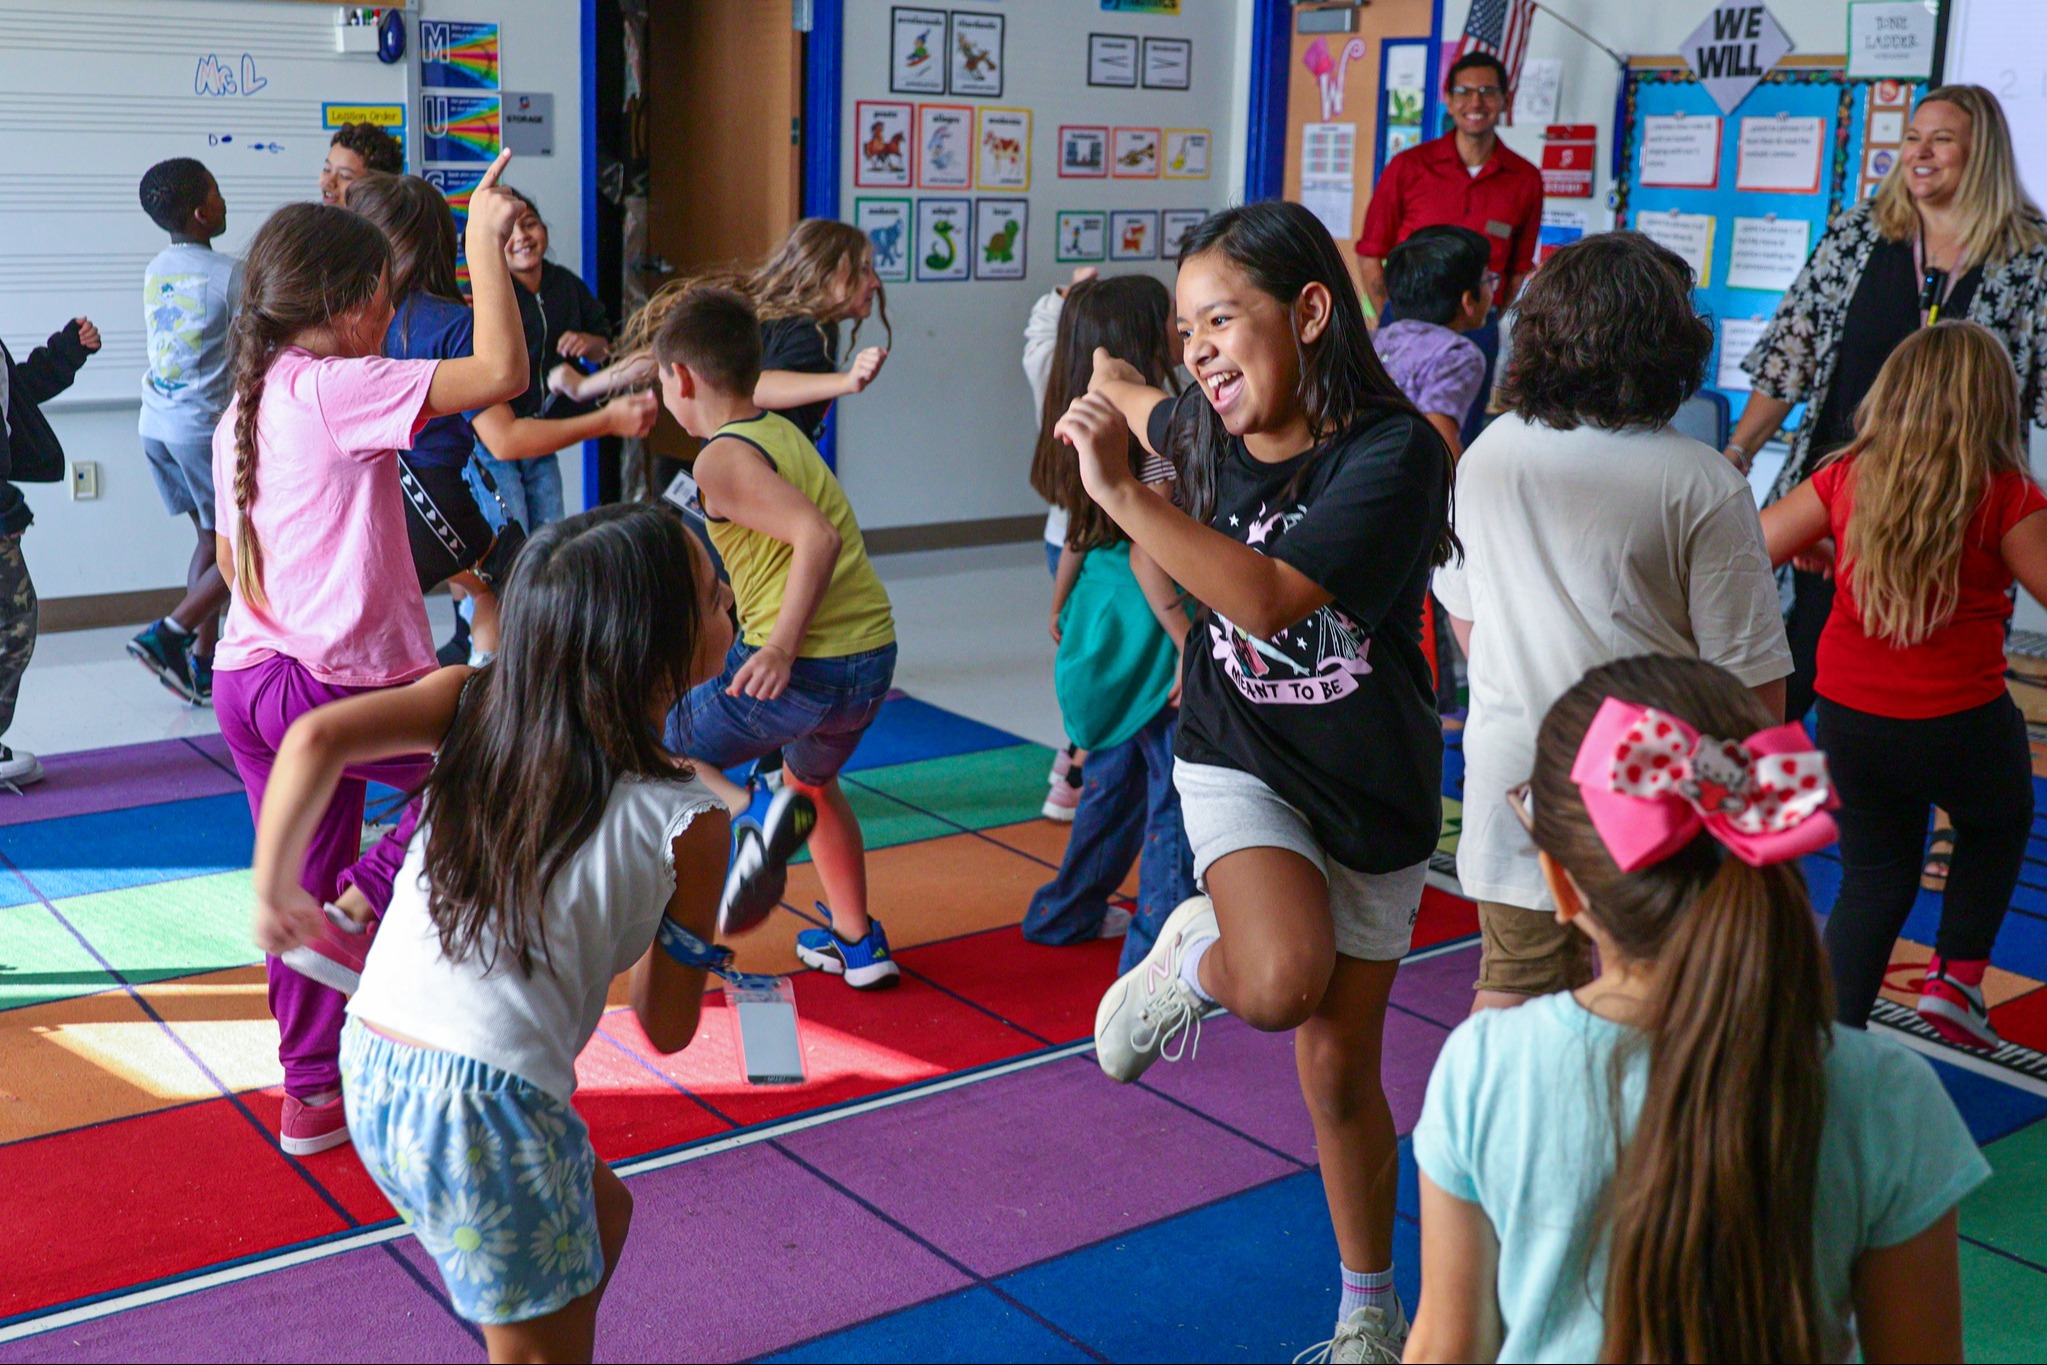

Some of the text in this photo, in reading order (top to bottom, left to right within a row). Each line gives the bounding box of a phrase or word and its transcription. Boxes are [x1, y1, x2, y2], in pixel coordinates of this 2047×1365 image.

[1714, 7, 1764, 41] WE
[421, 22, 450, 63] M
[1864, 35, 1919, 49] LADDER
[1697, 43, 1763, 79] WILL
[369, 110, 398, 121] Order
[424, 97, 448, 139] U
[506, 115, 543, 124] STORAGE
[1231, 665, 1344, 701] MEANT TO BE
